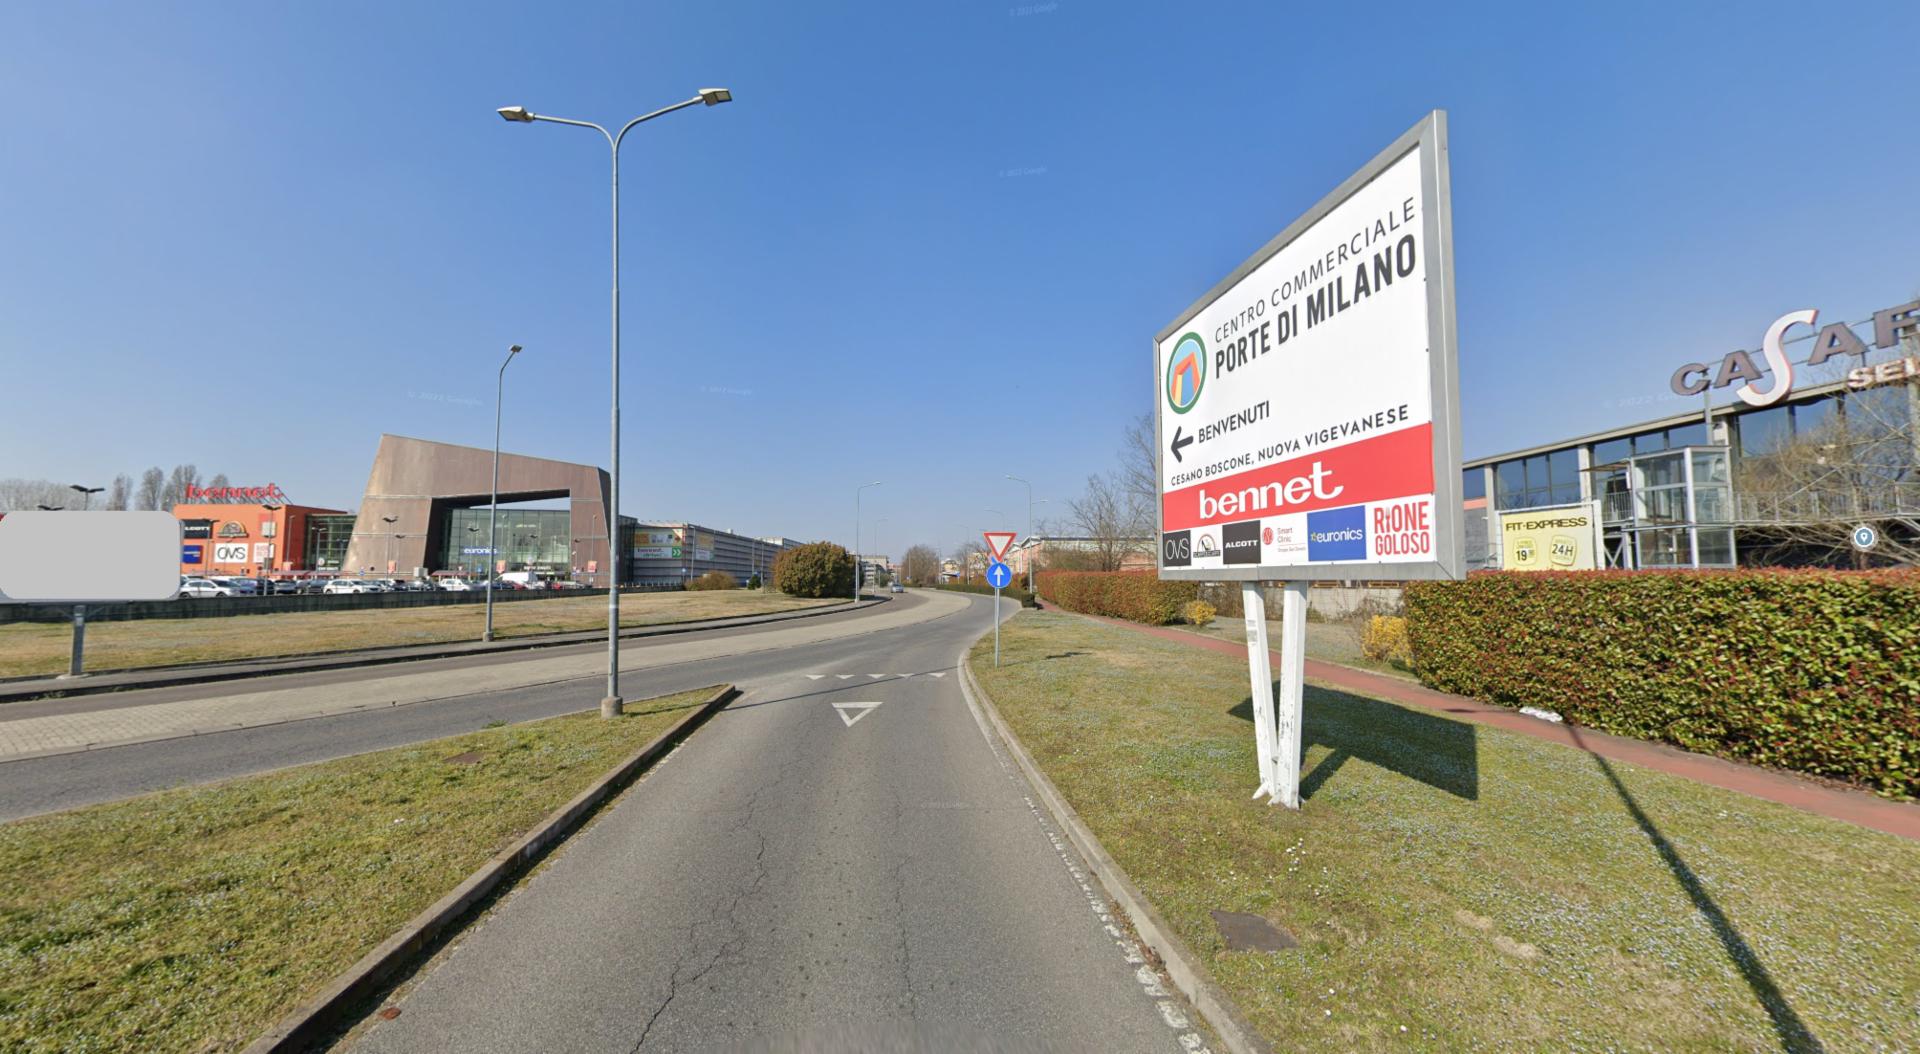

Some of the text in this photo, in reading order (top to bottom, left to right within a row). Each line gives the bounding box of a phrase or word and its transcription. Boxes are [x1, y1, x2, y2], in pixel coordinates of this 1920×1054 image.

[1215, 196, 1415, 343] CENTRO COMMERCIALE
[1215, 233, 1417, 379] PORTE DI MILANO
[1198, 400, 1270, 444] BENVENUTI
[1170, 403, 1409, 486] CESANO BOSCONE, NUOVA VIGEVANESE
[186, 483, 284, 500] bennet
[1199, 461, 1345, 520] bennet
[1373, 500, 1430, 534] RIONE
[1165, 537, 1190, 560] OVS
[1225, 539, 1259, 549] ALCOTT
[1316, 527, 1364, 543] euronics
[1375, 531, 1430, 556] GOLOSO
[217, 546, 246, 560] OVS
